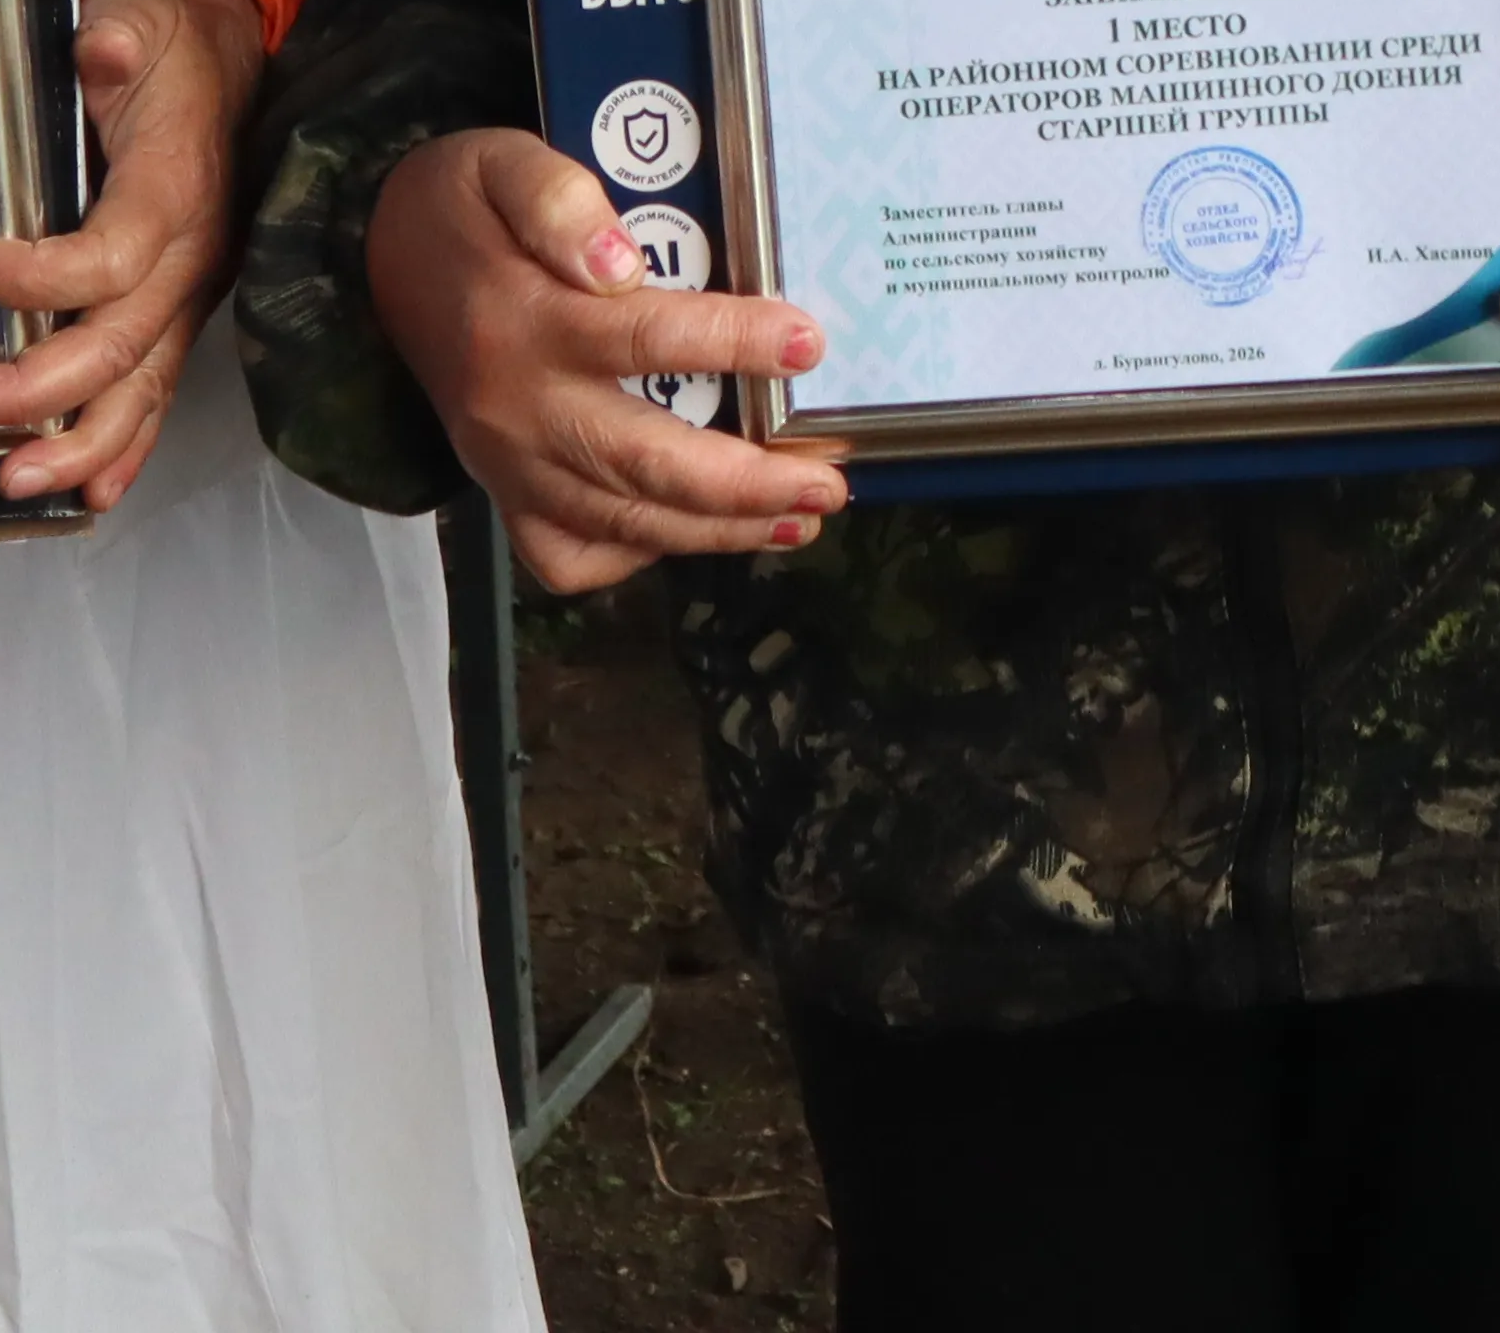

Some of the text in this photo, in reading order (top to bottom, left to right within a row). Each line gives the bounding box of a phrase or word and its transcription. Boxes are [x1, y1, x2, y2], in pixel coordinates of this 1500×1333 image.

[1109, 13, 1248, 42] 1 МЕСТО
[878, 33, 1482, 91] НА РАЙОННОМ СОРЕВНОВАНИИ СРЕДИ
[900, 64, 1463, 120] ОПЕРАТОРОВ МАШИННОГО ДОЕНИЯ
[599, 87, 691, 131] ДВОЙНАЯ ЗАЩИТА
[1037, 103, 1329, 140] СТАРШЕЙ ГРУППЫ
[615, 162, 683, 184] ДВИГАТЕЛЯ
[626, 211, 691, 234] ЛЮМИНИЙ
[879, 197, 1064, 222] Заместитель главы
[883, 223, 1037, 247] Администрации
[884, 242, 1108, 271] по сельскому хозяйству
[1415, 244, 1495, 261] Хасанов
[903, 271, 1069, 296] муниципальному
[1075, 264, 1170, 288] контролю
[1228, 345, 1265, 361] 2026
